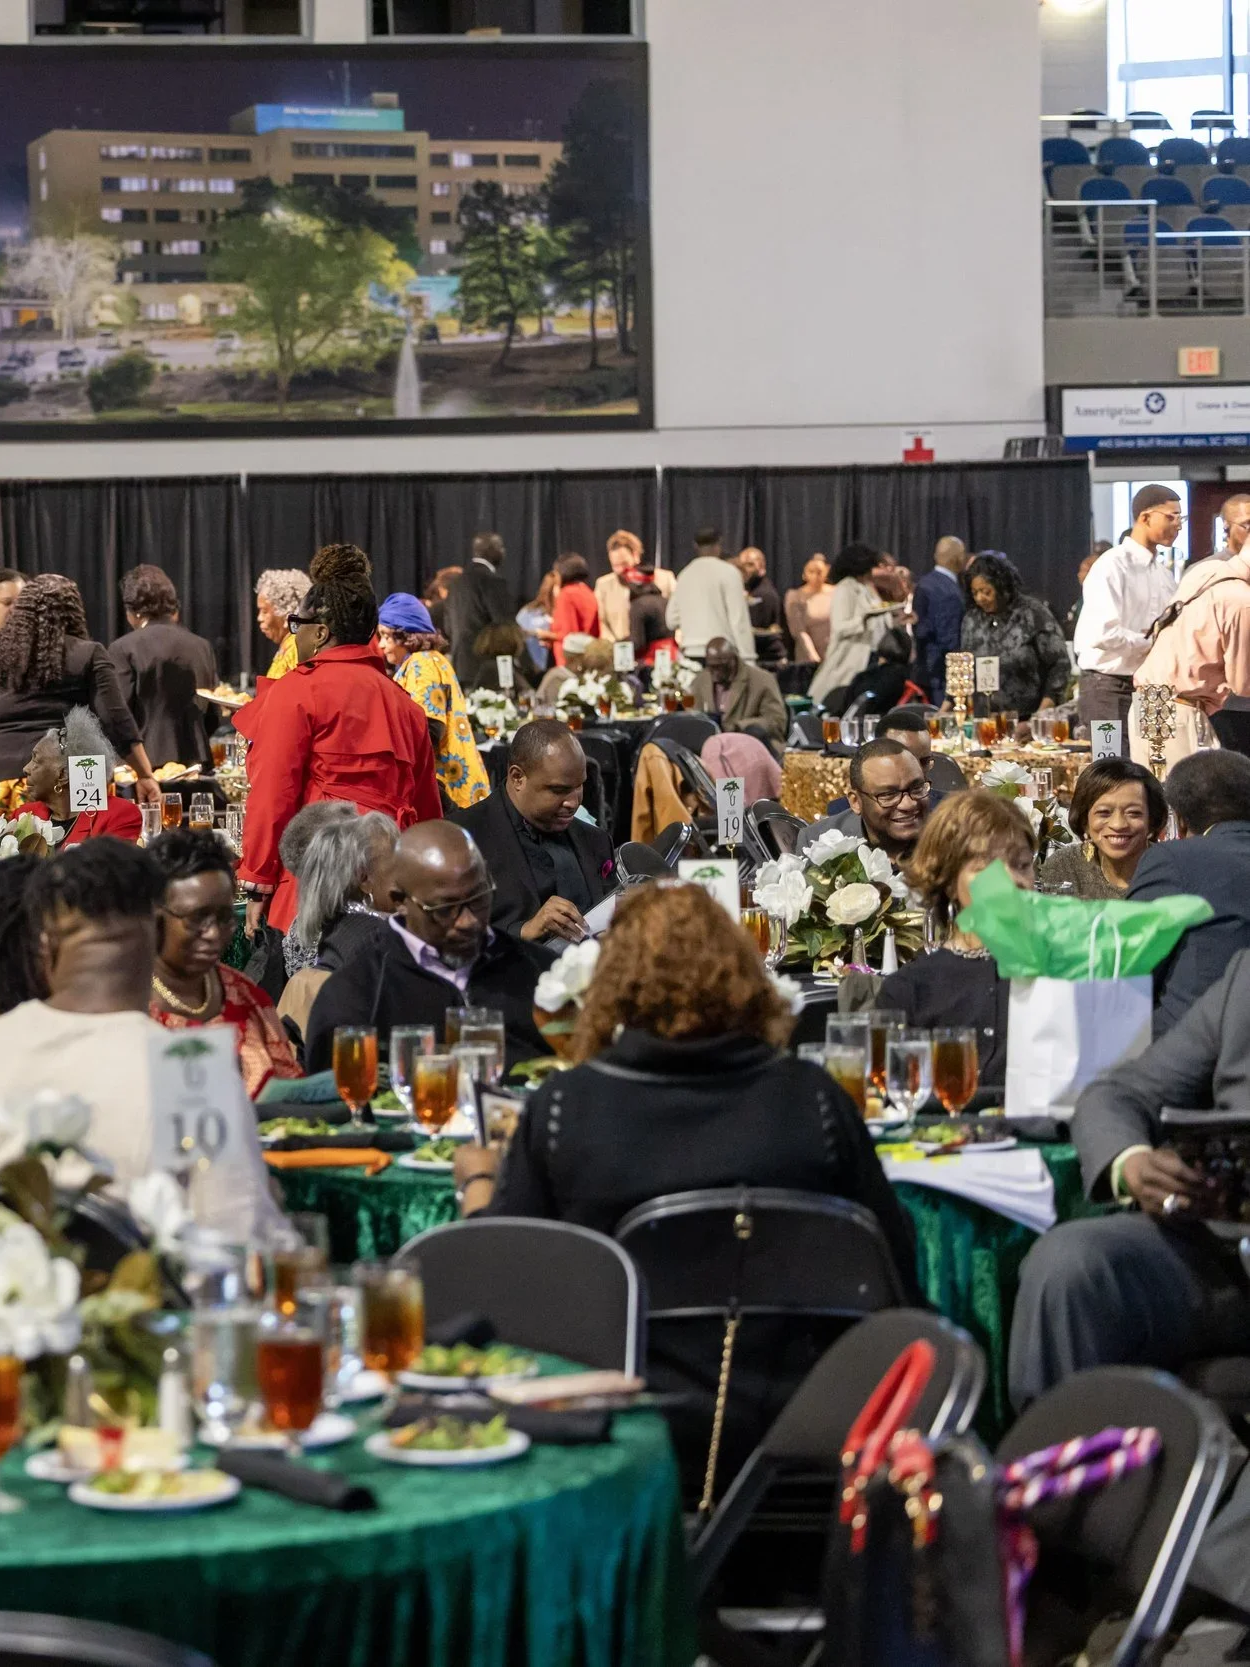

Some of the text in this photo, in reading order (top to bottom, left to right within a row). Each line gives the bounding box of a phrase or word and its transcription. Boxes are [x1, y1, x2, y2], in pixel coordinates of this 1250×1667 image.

[76, 788, 102, 807] 24
[723, 816, 740, 840] 19
[170, 1107, 228, 1162] 10
